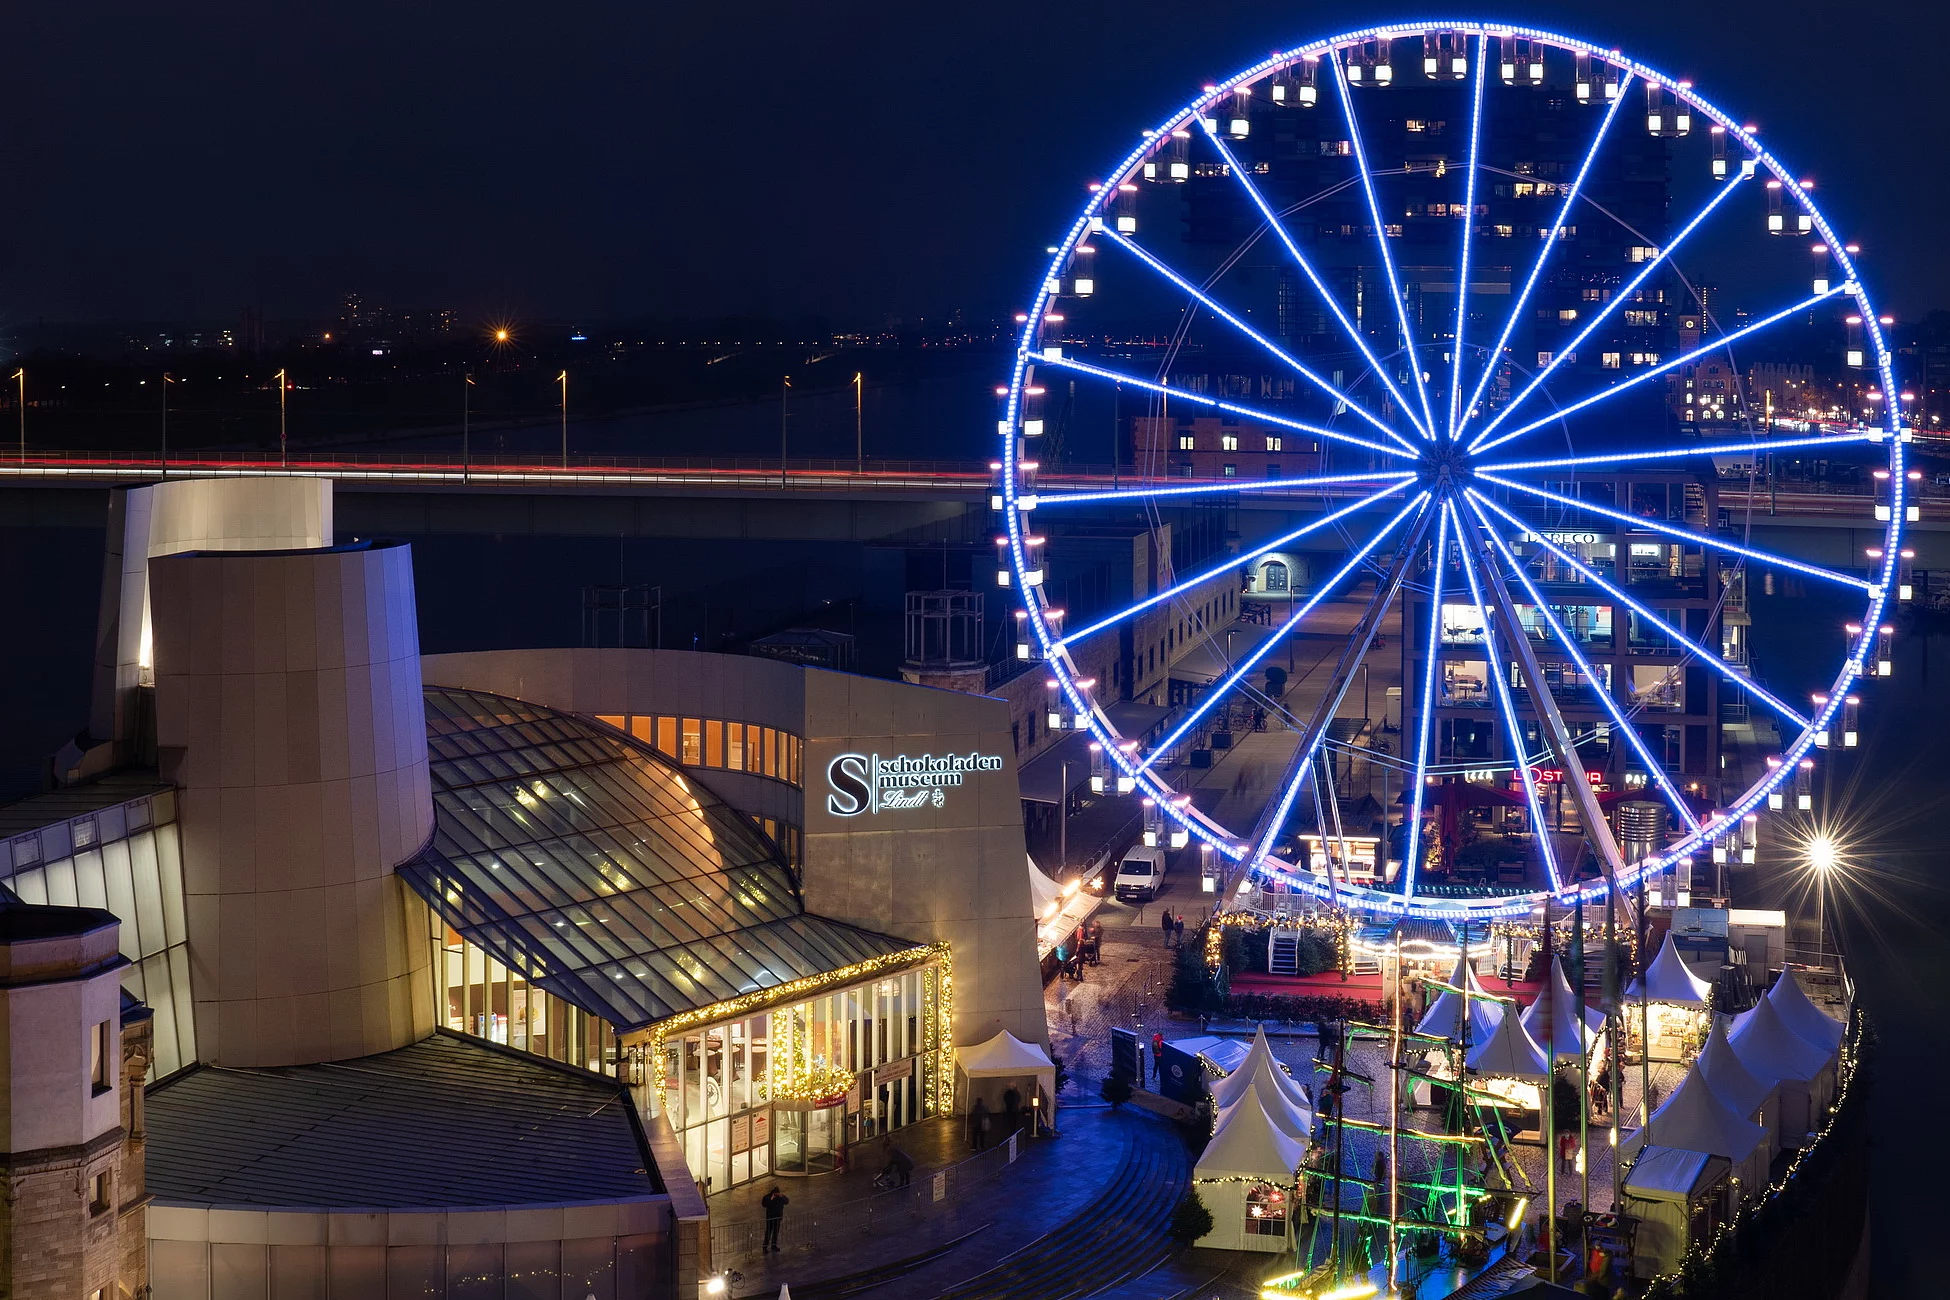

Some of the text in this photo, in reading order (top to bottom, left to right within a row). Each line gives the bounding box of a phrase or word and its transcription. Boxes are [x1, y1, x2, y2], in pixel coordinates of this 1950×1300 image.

[1527, 533, 1595, 544] DRECO
[880, 753, 1001, 773] schokoladen
[880, 773, 961, 787] museum
[880, 791, 929, 808] Lindt
